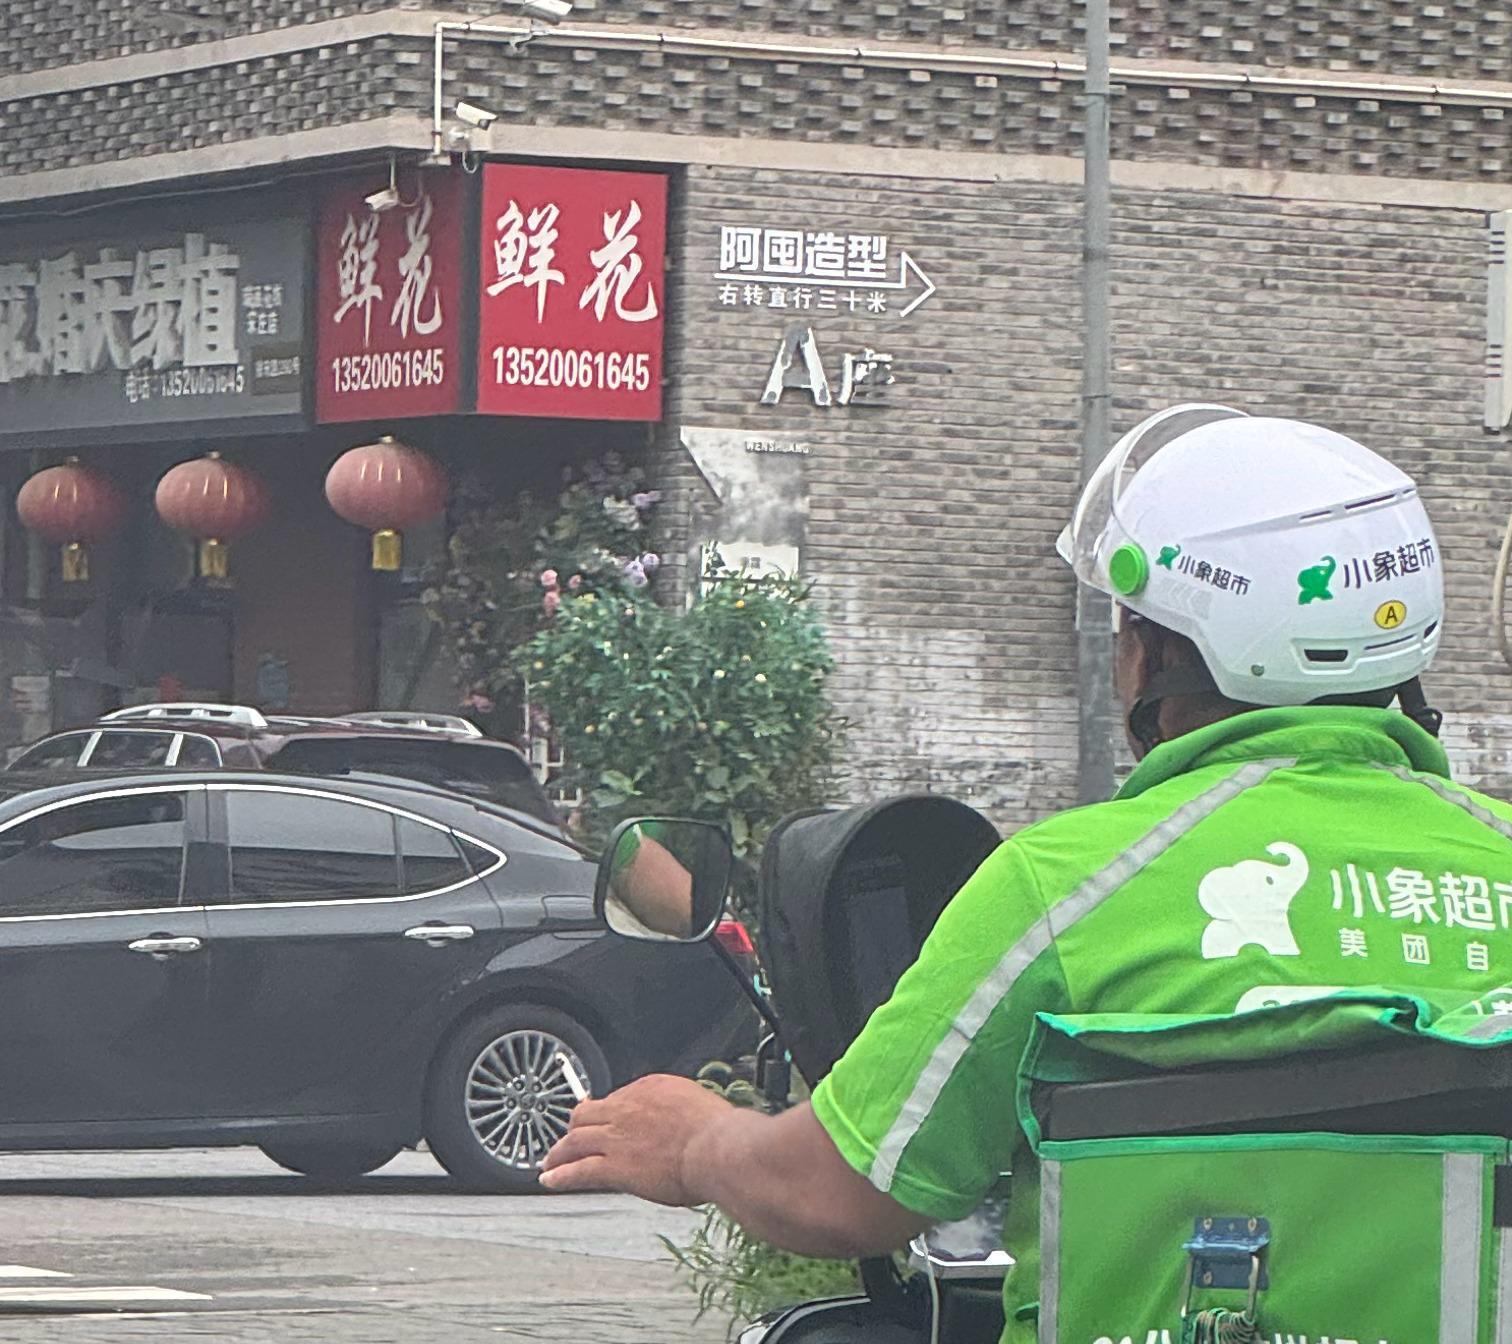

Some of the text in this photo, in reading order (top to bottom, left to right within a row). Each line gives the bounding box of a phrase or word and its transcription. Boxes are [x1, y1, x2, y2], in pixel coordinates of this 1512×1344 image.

[334, 194, 442, 347] 鲜花
[487, 200, 658, 324] 鲜花
[719, 226, 887, 279] 阿囤造型
[718, 283, 887, 314] 右转直行三十米
[332, 349, 444, 392] 13520061645
[493, 346, 650, 391] 13520061645
[1177, 555, 1251, 596] 小象超市
[1344, 538, 1436, 589] 小象超市
[1384, 605, 1398, 624] A
